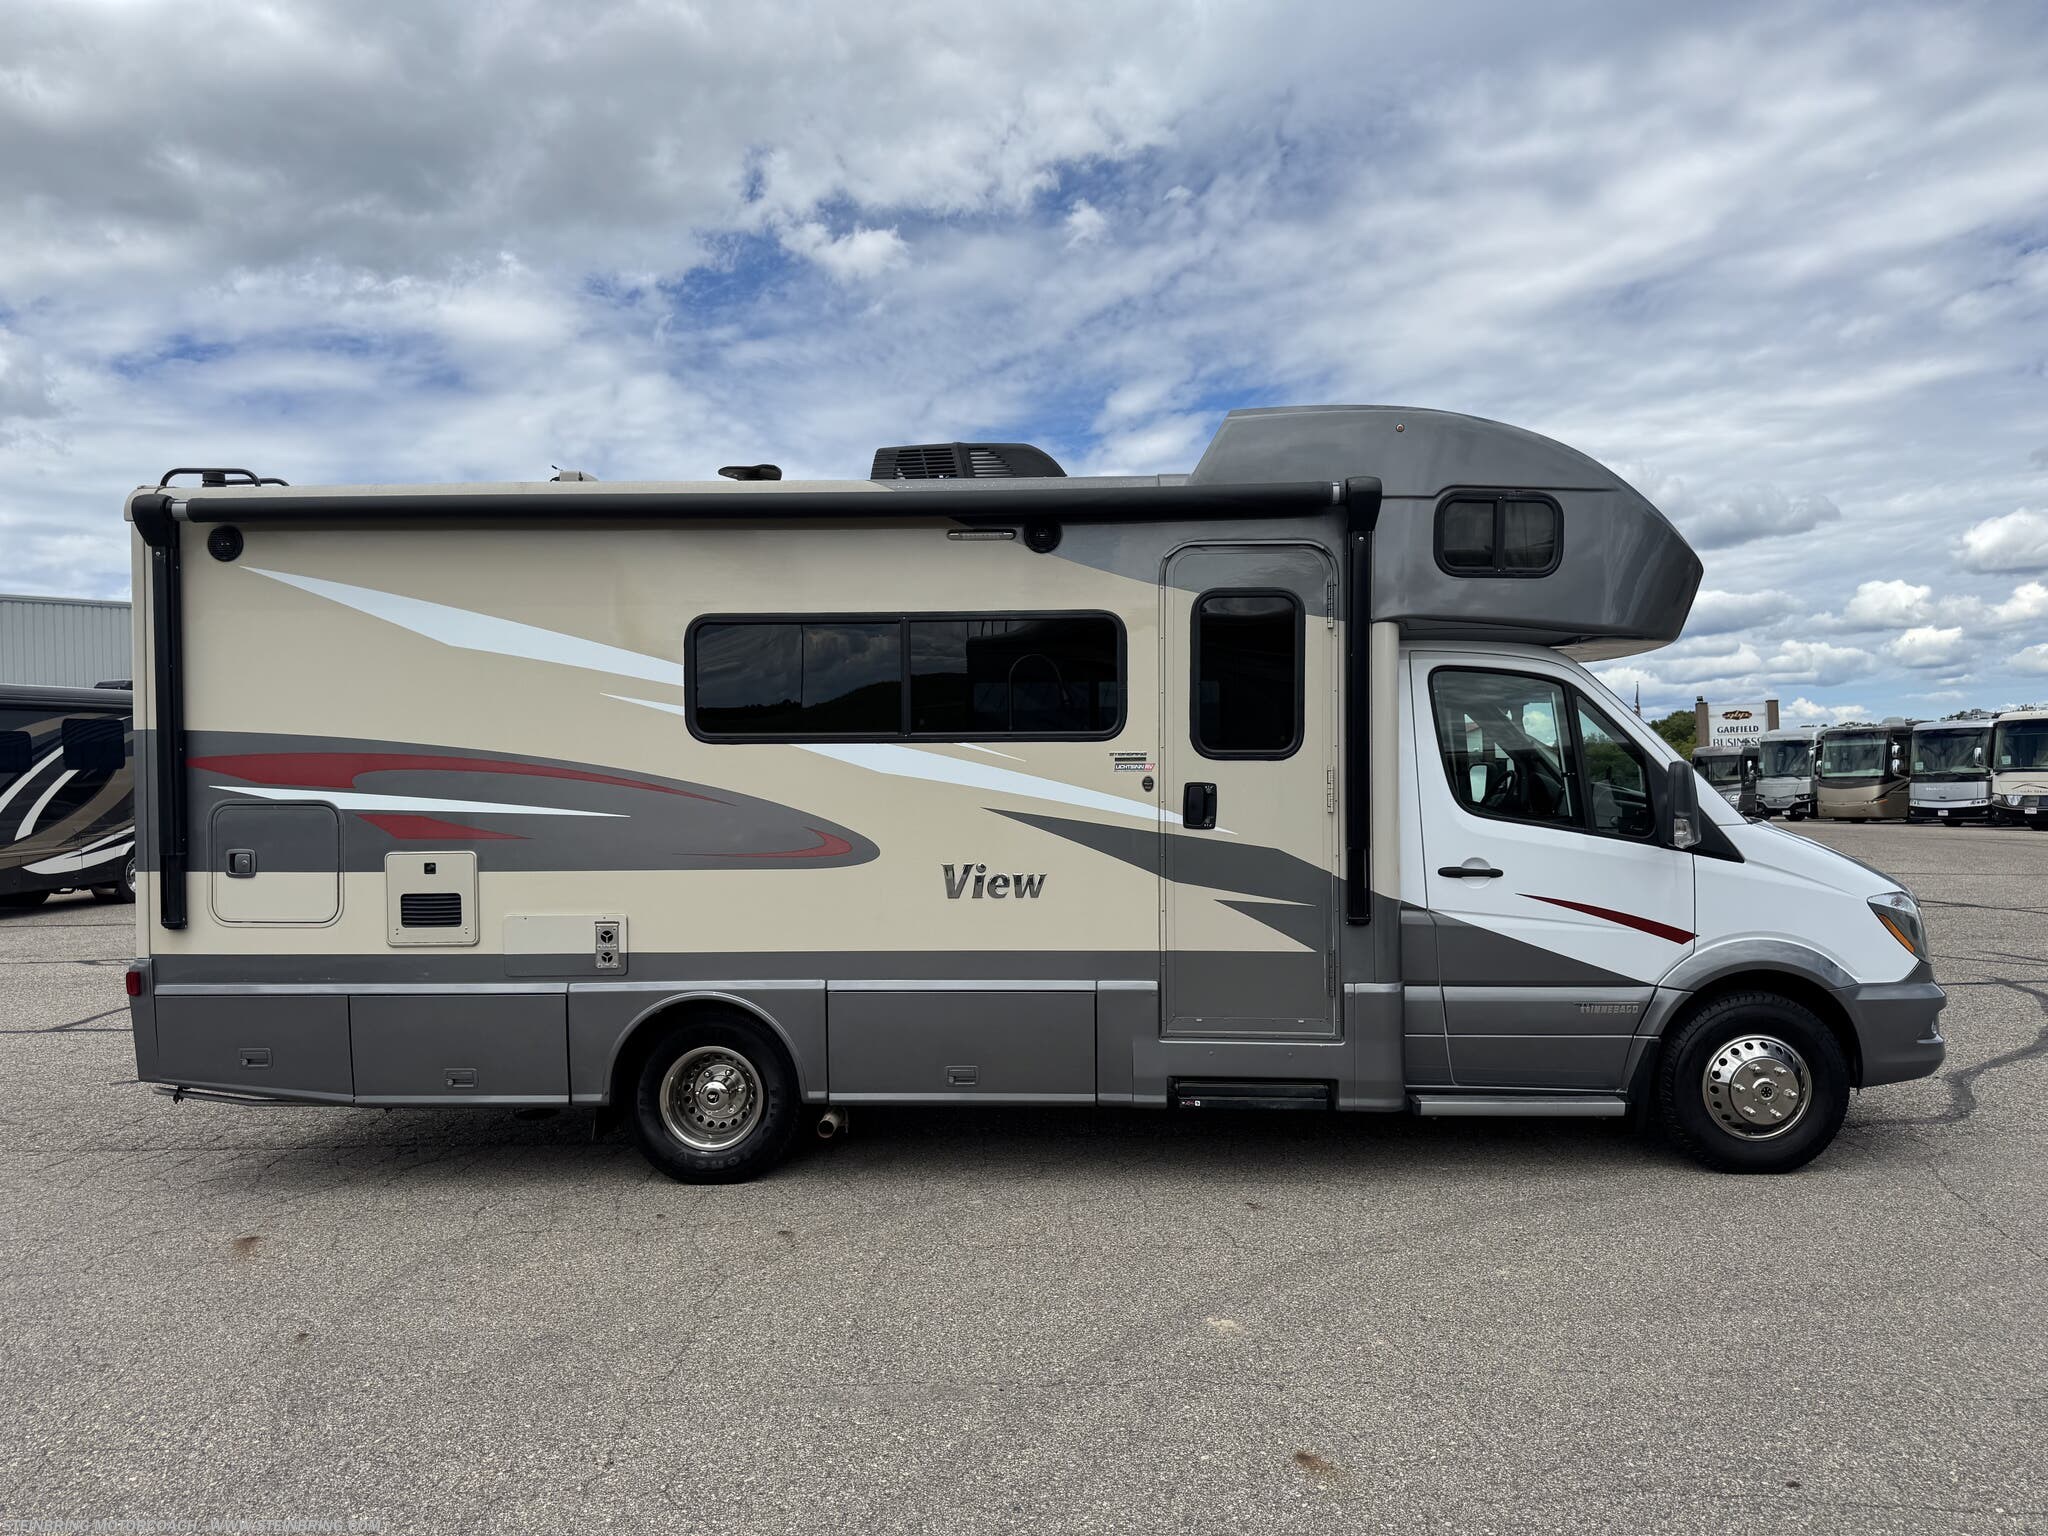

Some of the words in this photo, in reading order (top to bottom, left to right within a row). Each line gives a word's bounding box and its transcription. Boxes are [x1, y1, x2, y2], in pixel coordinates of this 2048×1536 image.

[1717, 725, 1759, 733] GARFIELD
[941, 863, 1047, 899] View
[1580, 1003, 1639, 1014] WINNEBAGO
